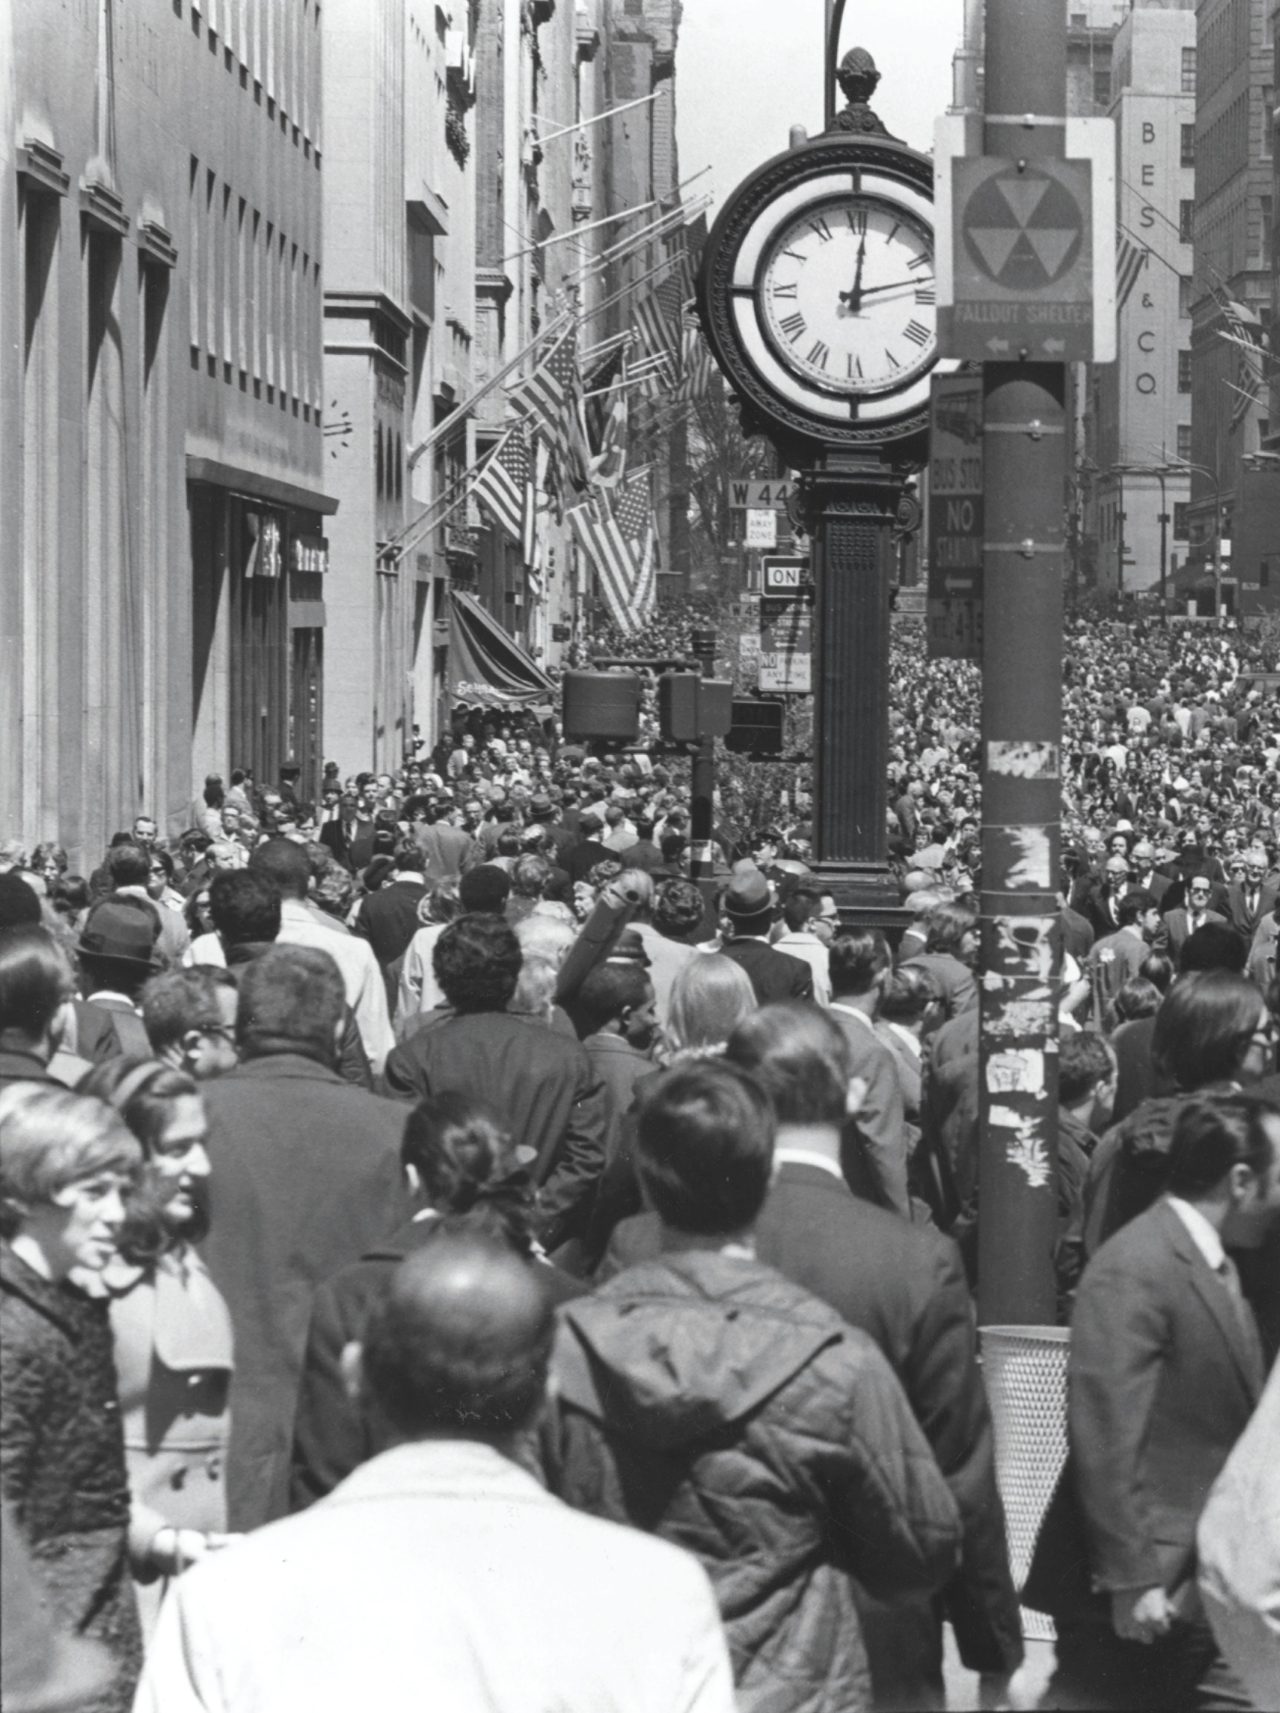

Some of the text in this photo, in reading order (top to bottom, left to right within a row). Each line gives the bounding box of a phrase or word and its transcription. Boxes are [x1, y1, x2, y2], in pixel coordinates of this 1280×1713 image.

[1139, 122, 1156, 270] BEST
[885, 223, 900, 245] I
[783, 247, 808, 267] X
[906, 252, 931, 270] II
[914, 289, 936, 306] III
[1141, 293, 1154, 308] &
[954, 303, 1091, 324] FALLOUT SHELTER
[959, 458, 983, 490] STO
[733, 483, 788, 506] W 44
[947, 500, 975, 532] NO
